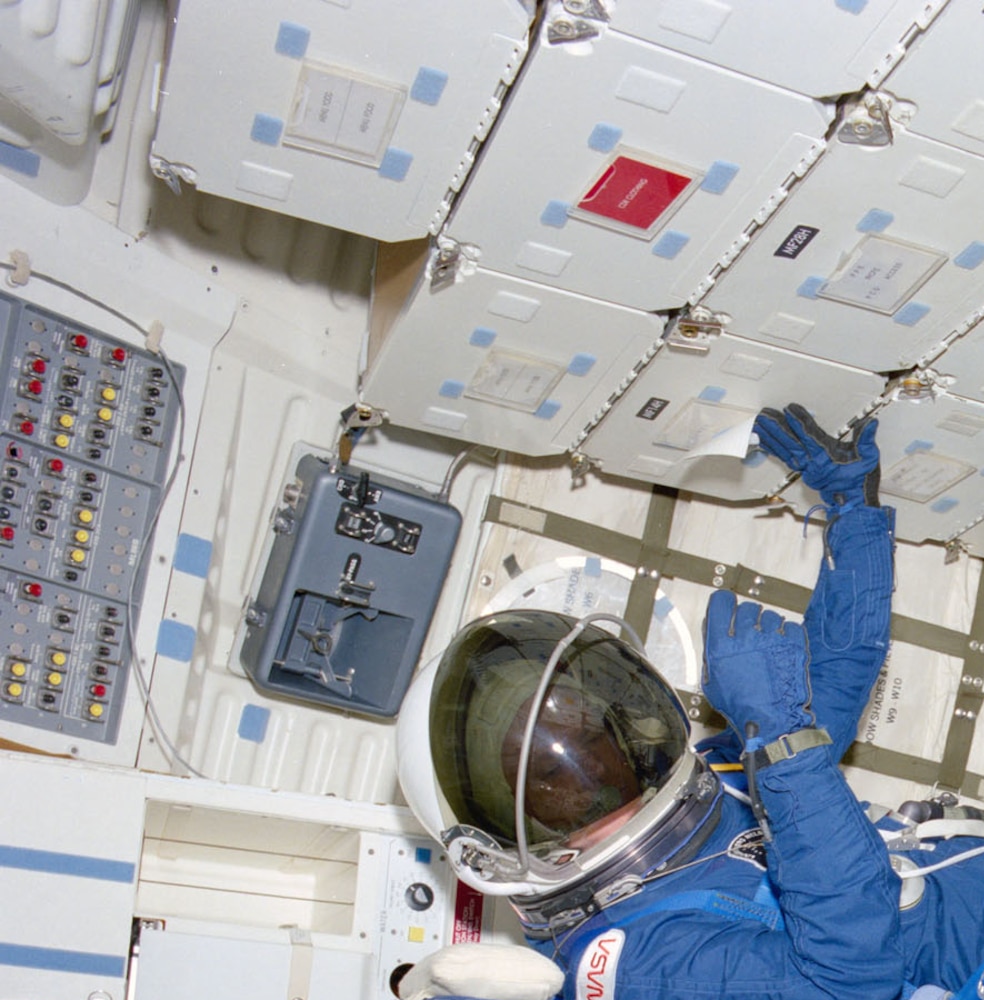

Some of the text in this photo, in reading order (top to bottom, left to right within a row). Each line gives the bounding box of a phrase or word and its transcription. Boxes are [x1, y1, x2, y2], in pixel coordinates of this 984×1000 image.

[625, 178, 648, 201] CLOTHING
[781, 229, 812, 255] MF28H
[870, 679, 887, 721] SHADES
[891, 677, 902, 700] W10
[886, 707, 897, 724] W9
